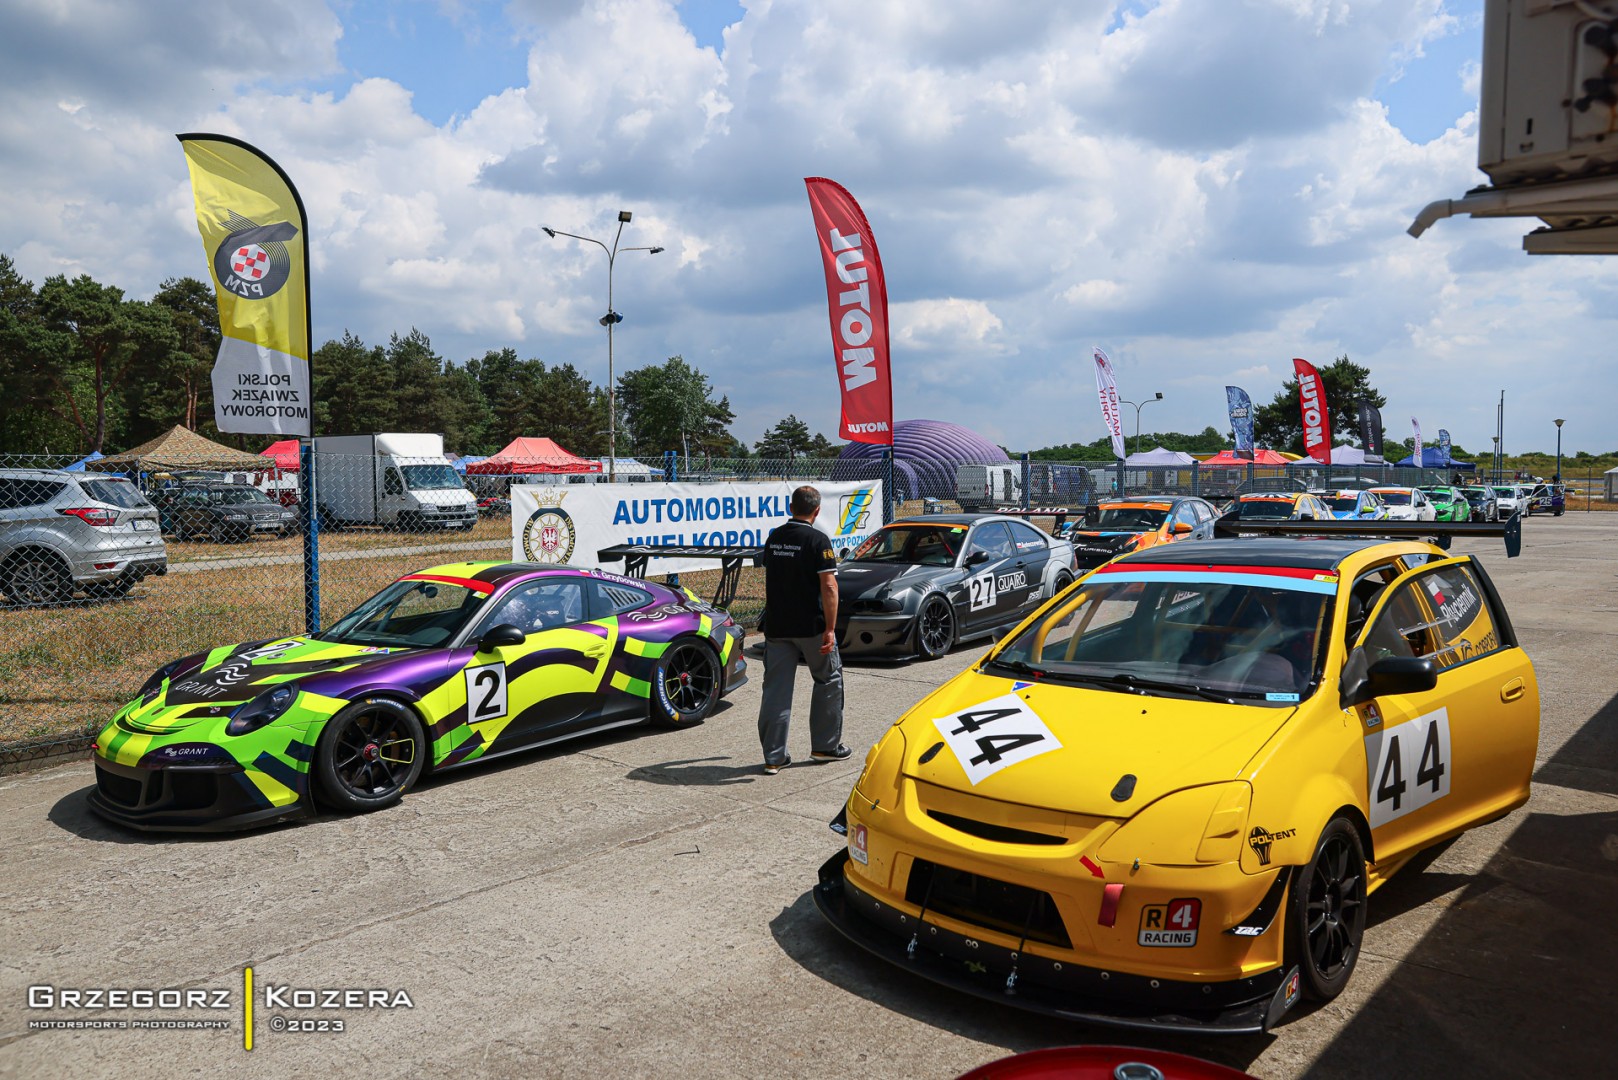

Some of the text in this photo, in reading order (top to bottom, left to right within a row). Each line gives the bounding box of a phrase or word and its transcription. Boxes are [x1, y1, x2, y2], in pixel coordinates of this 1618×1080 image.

[612, 495, 794, 526] AUTOMOBILKLU
[971, 575, 993, 608] 27
[175, 681, 228, 698] GRANT
[474, 669, 501, 718] 2
[950, 707, 1046, 768] 44
[1376, 719, 1445, 812] 44
[1249, 828, 1297, 847] POLTENT
[1144, 932, 1192, 944] RACING
